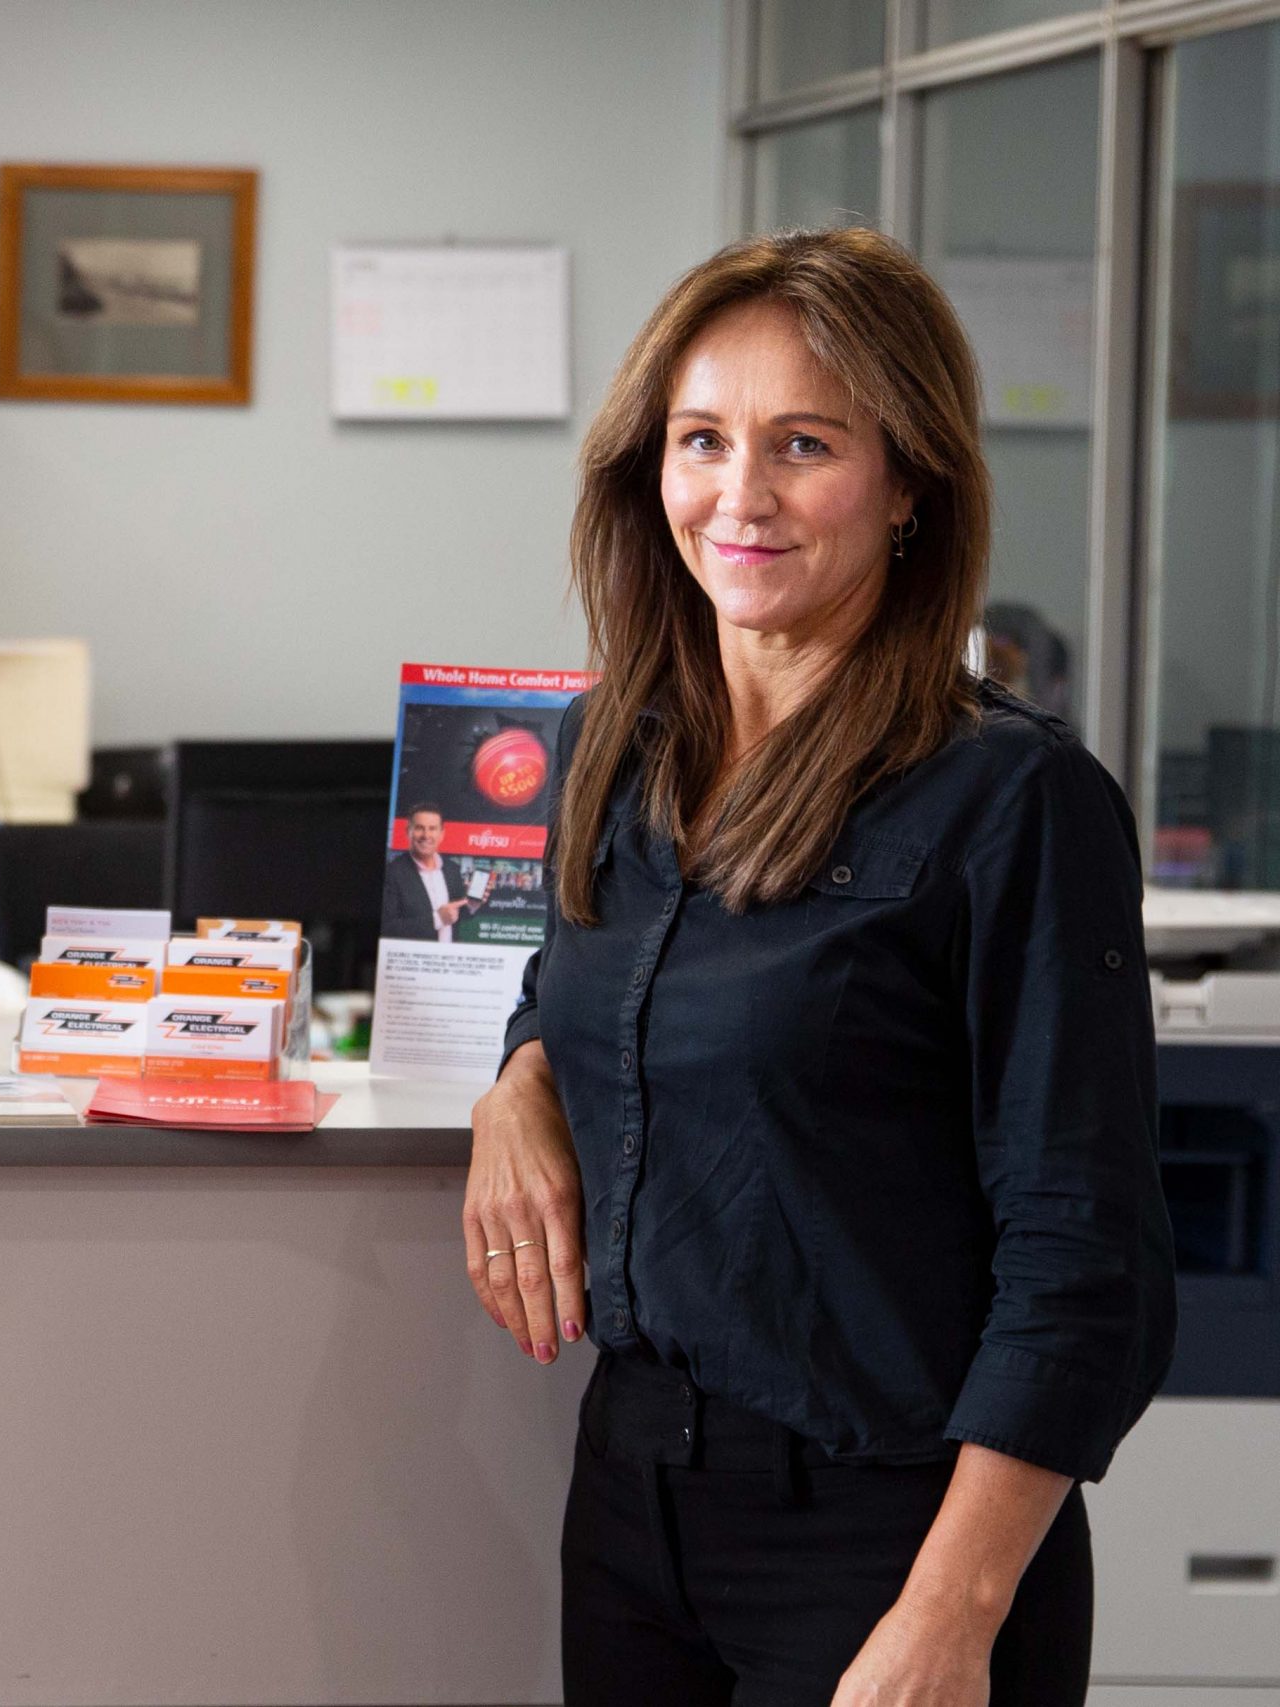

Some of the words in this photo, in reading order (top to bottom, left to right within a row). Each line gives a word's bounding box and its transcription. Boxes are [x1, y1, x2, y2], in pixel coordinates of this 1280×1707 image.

[423, 668, 464, 683] Whole
[468, 671, 506, 686] Home
[510, 674, 560, 688] Comfort
[469, 830, 509, 849] FUJITSU
[66, 952, 106, 960] ORANGE
[84, 961, 138, 969] ELECTRICAL
[192, 958, 234, 966] ORANGE
[51, 1012, 92, 1021] ORANGE
[171, 1014, 213, 1023] ORANGE
[67, 1022, 124, 1031] ELECTRICAL
[189, 1024, 246, 1034] ELECTRICAL
